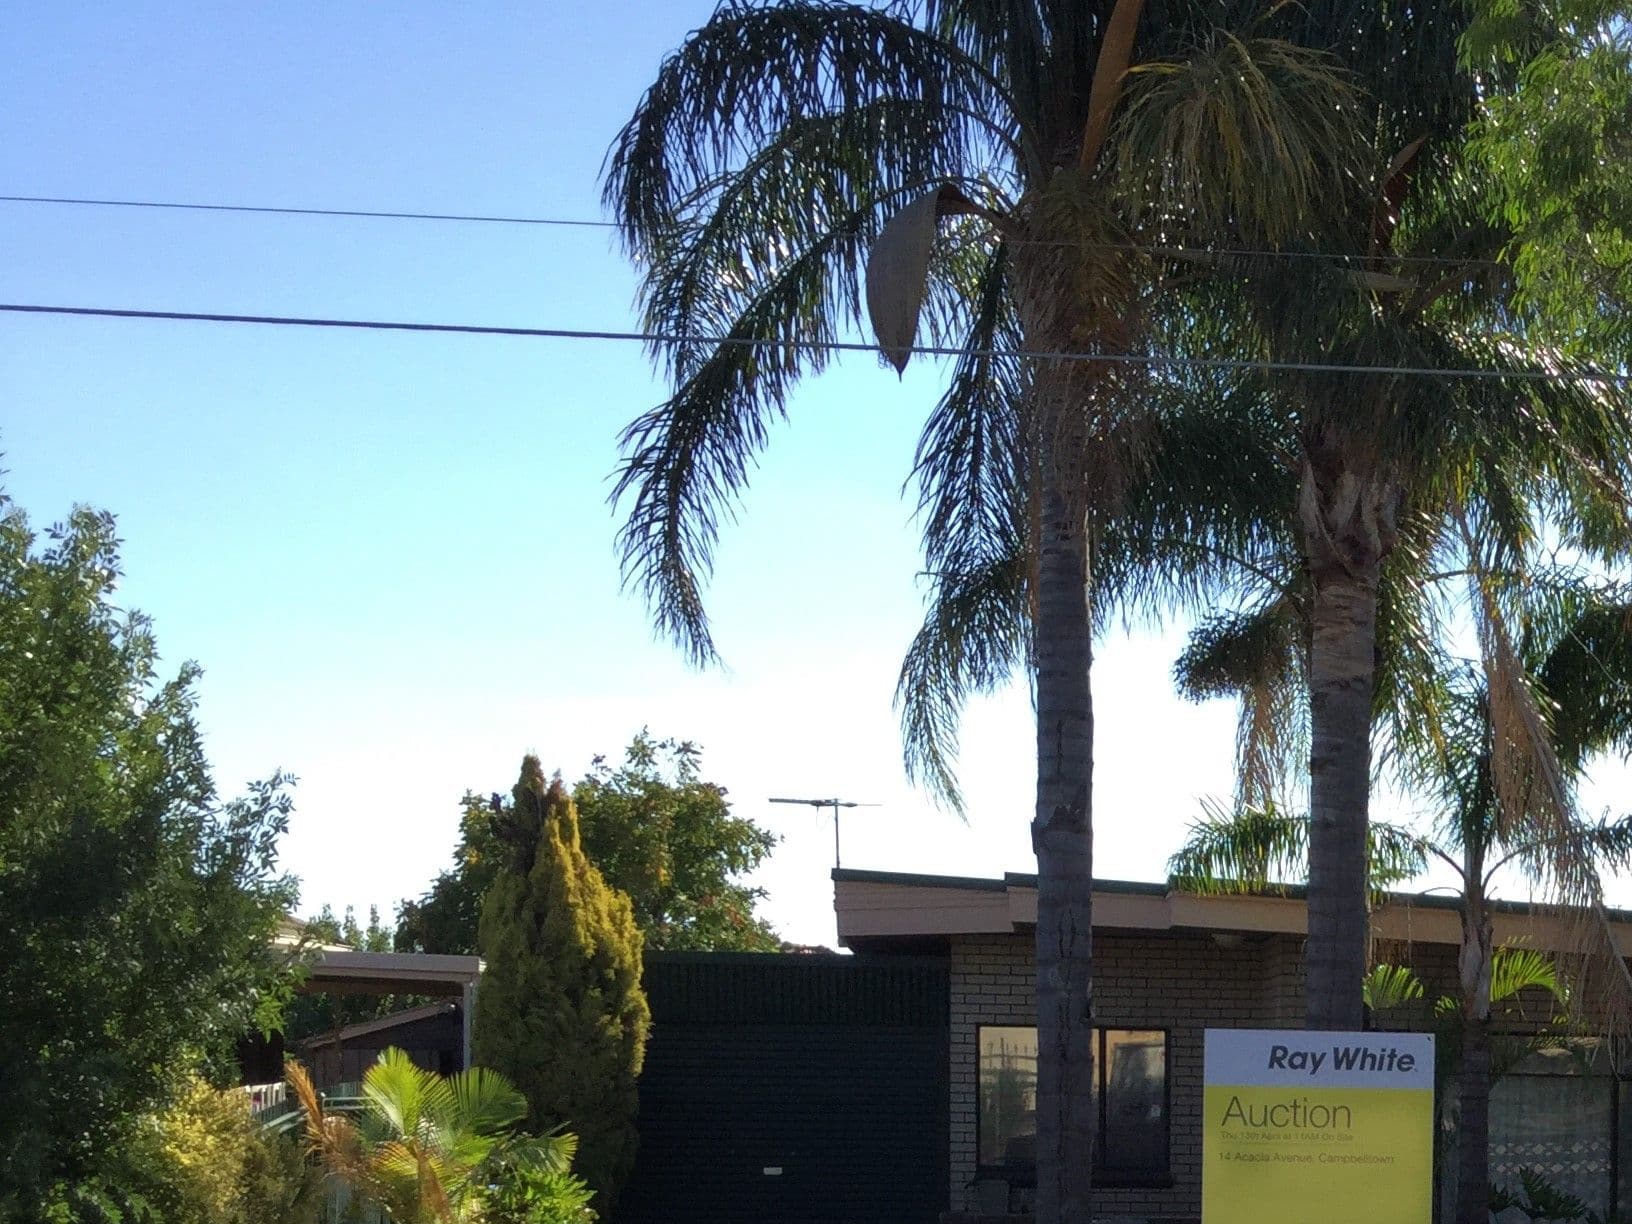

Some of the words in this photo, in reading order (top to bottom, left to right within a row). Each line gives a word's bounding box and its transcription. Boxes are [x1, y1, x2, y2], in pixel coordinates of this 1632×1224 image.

[1268, 1045, 1327, 1076] Ray
[1332, 1046, 1416, 1073] White
[1221, 1095, 1351, 1129] Auction
